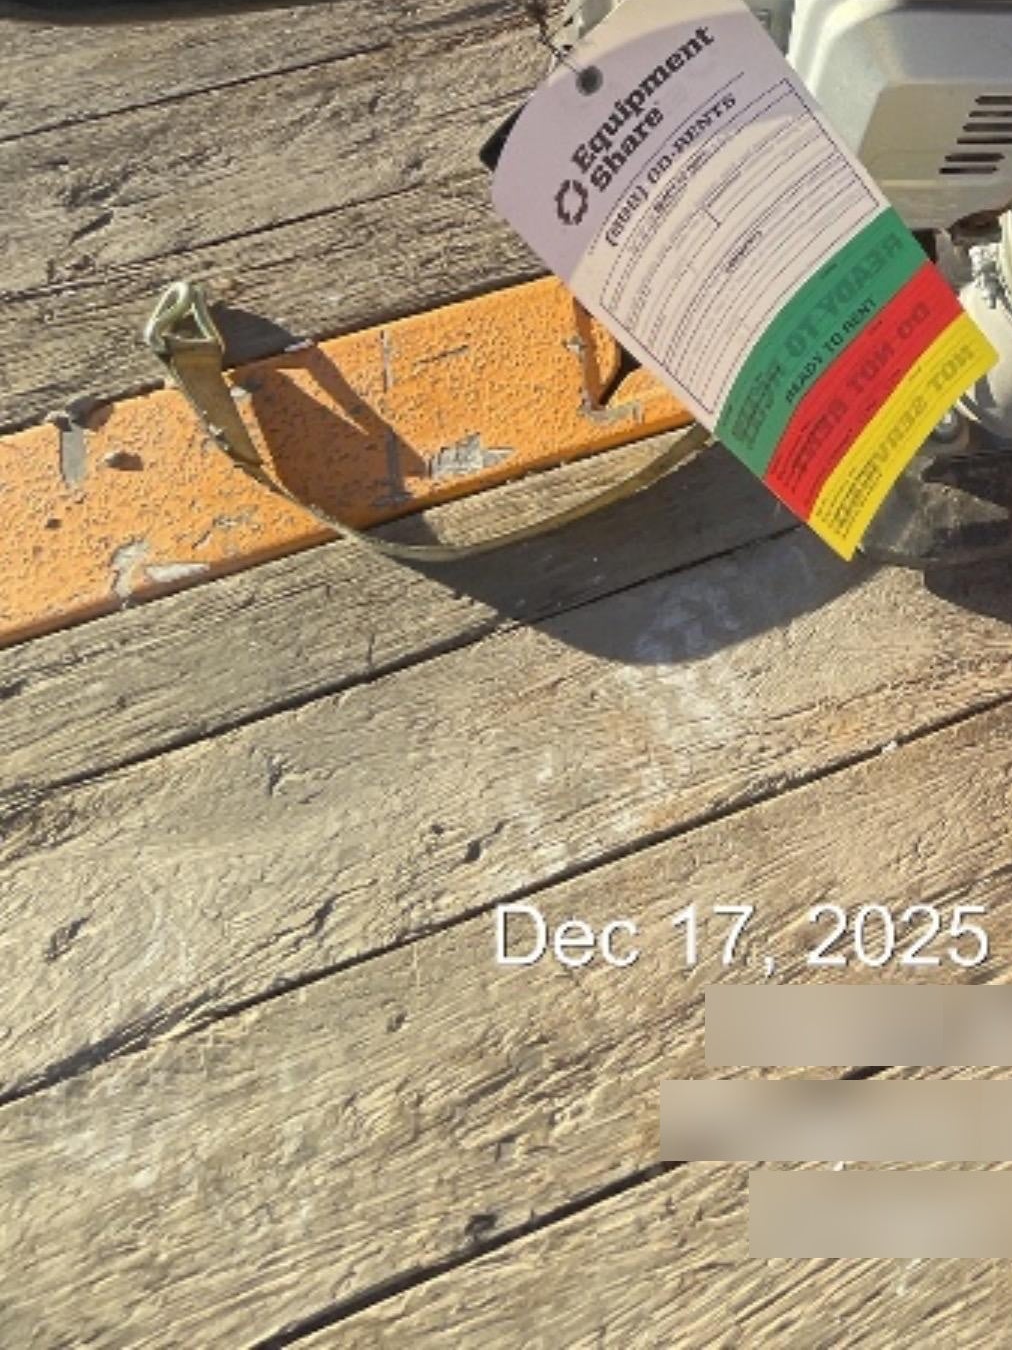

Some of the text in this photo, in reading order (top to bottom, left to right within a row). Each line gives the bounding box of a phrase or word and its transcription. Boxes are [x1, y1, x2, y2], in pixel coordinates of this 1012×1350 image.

[571, 26, 715, 174] Equipment
[590, 107, 664, 193] Share
[785, 298, 878, 403] READY TO RENT
